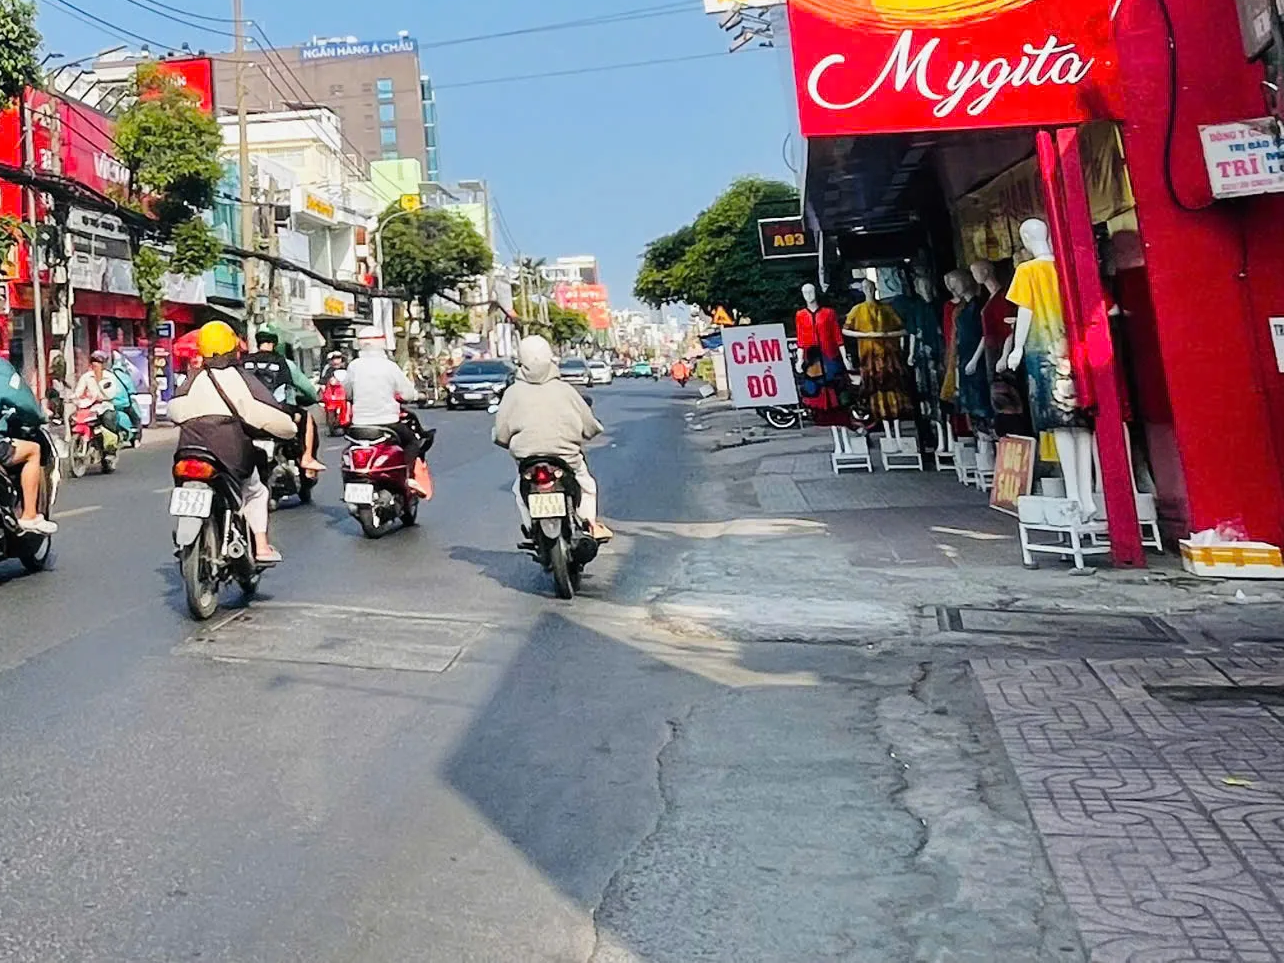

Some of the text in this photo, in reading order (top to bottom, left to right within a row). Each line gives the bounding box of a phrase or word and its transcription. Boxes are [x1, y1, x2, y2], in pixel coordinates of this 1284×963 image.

[302, 47, 336, 59] NGÂN
[337, 43, 370, 57] HÀNG
[807, 29, 1095, 118] Mygita
[773, 232, 805, 248] A93
[731, 331, 784, 365] CẦM
[747, 365, 778, 398] ĐỒ
